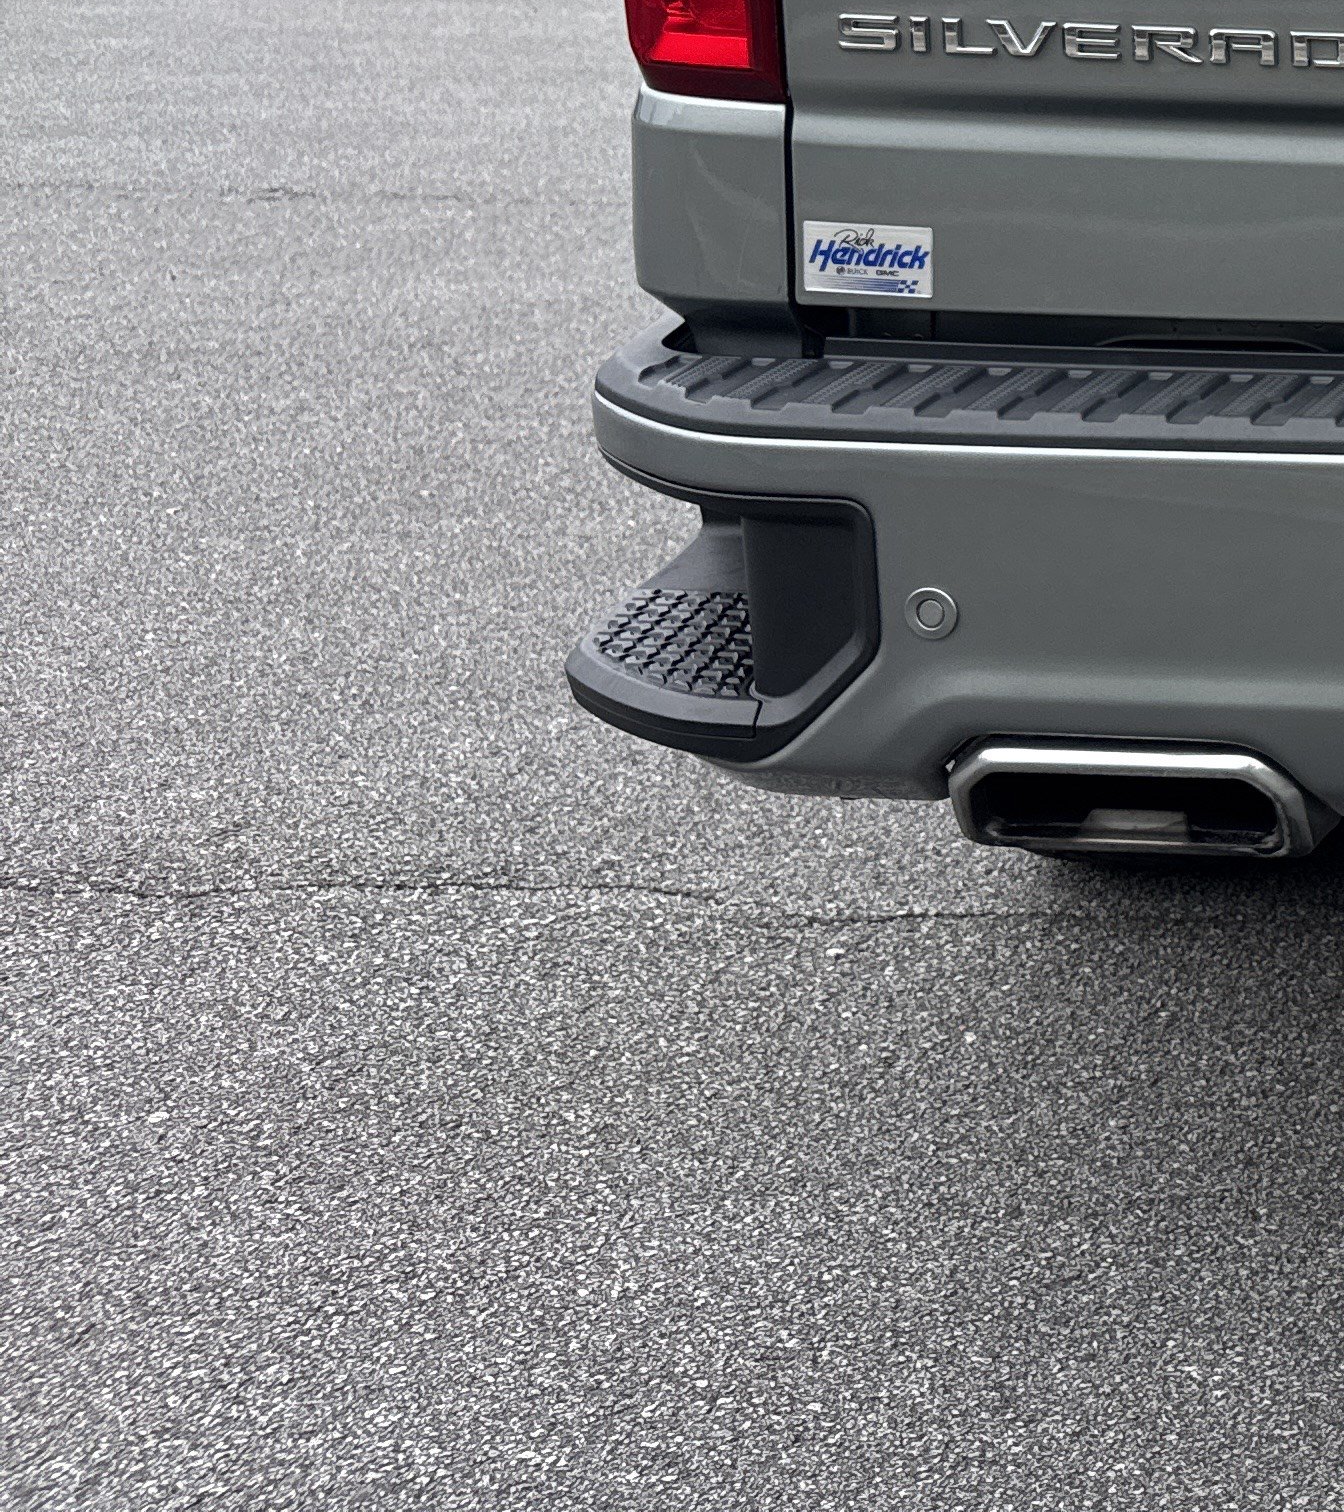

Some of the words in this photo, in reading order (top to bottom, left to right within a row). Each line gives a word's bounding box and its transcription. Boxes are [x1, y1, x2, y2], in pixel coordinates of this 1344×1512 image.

[834, 228, 875, 251] Rick
[808, 239, 930, 272] Hendrick
[876, 269, 899, 277] GMC
